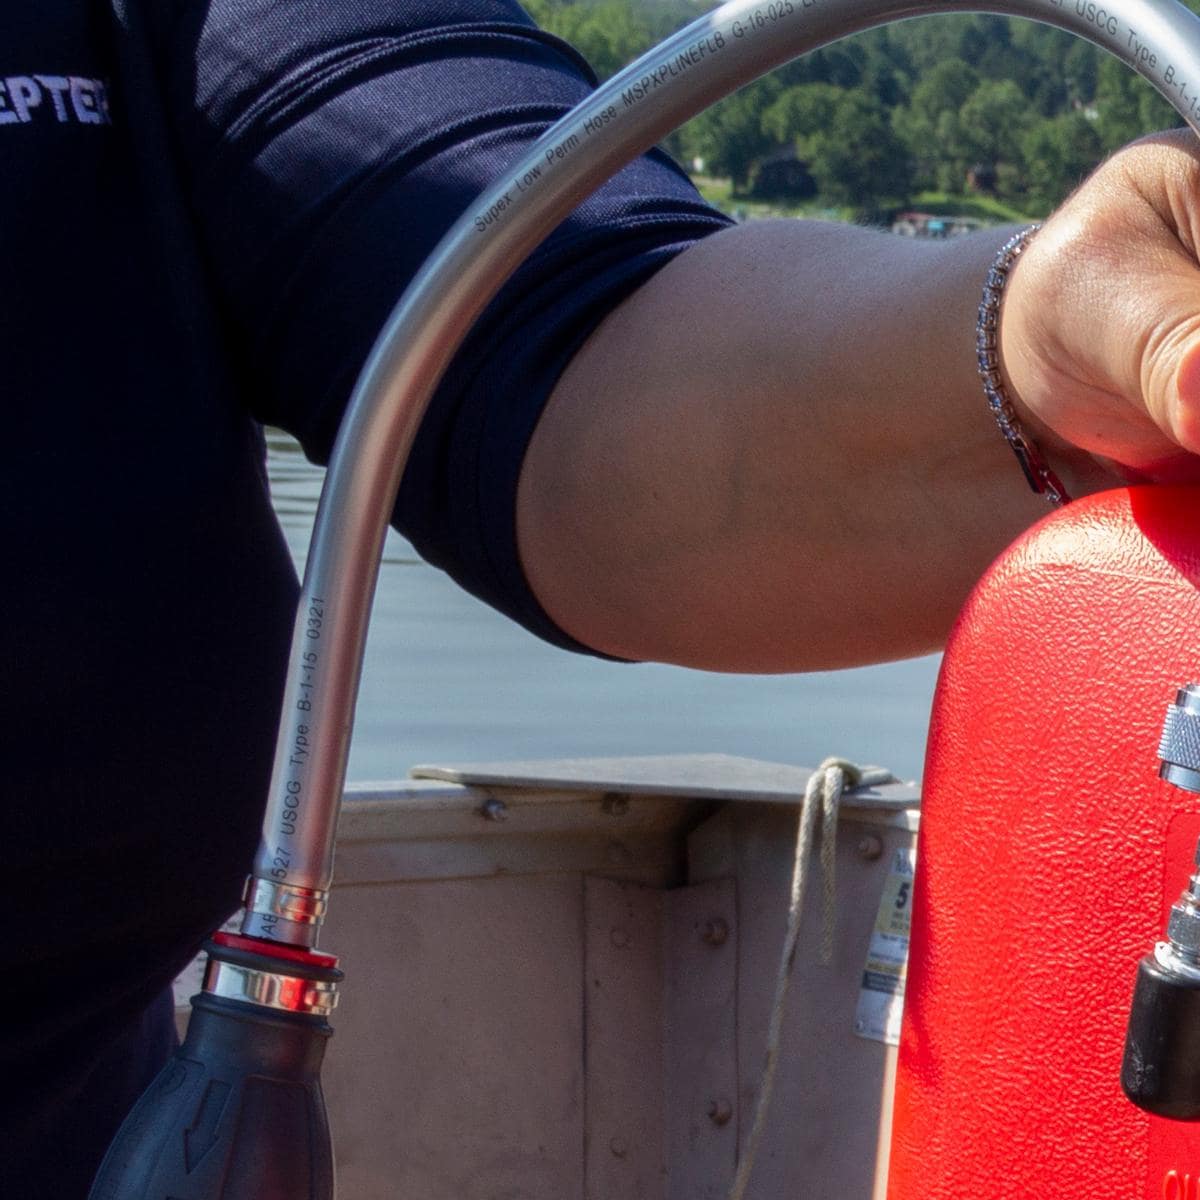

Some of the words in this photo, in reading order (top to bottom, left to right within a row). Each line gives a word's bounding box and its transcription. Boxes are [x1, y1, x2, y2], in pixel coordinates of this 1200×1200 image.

[1076, 0, 1118, 36] USCG
[1126, 29, 1157, 69] Type
[514, 165, 542, 192] Low
[545, 133, 580, 165] Perm
[583, 107, 618, 137] Hose
[732, 1, 795, 39] G-16-025
[308, 596, 326, 641] 0321
[297, 652, 318, 712] B-1-15
[290, 724, 309, 766] Type
[283, 780, 302, 835] USCG
